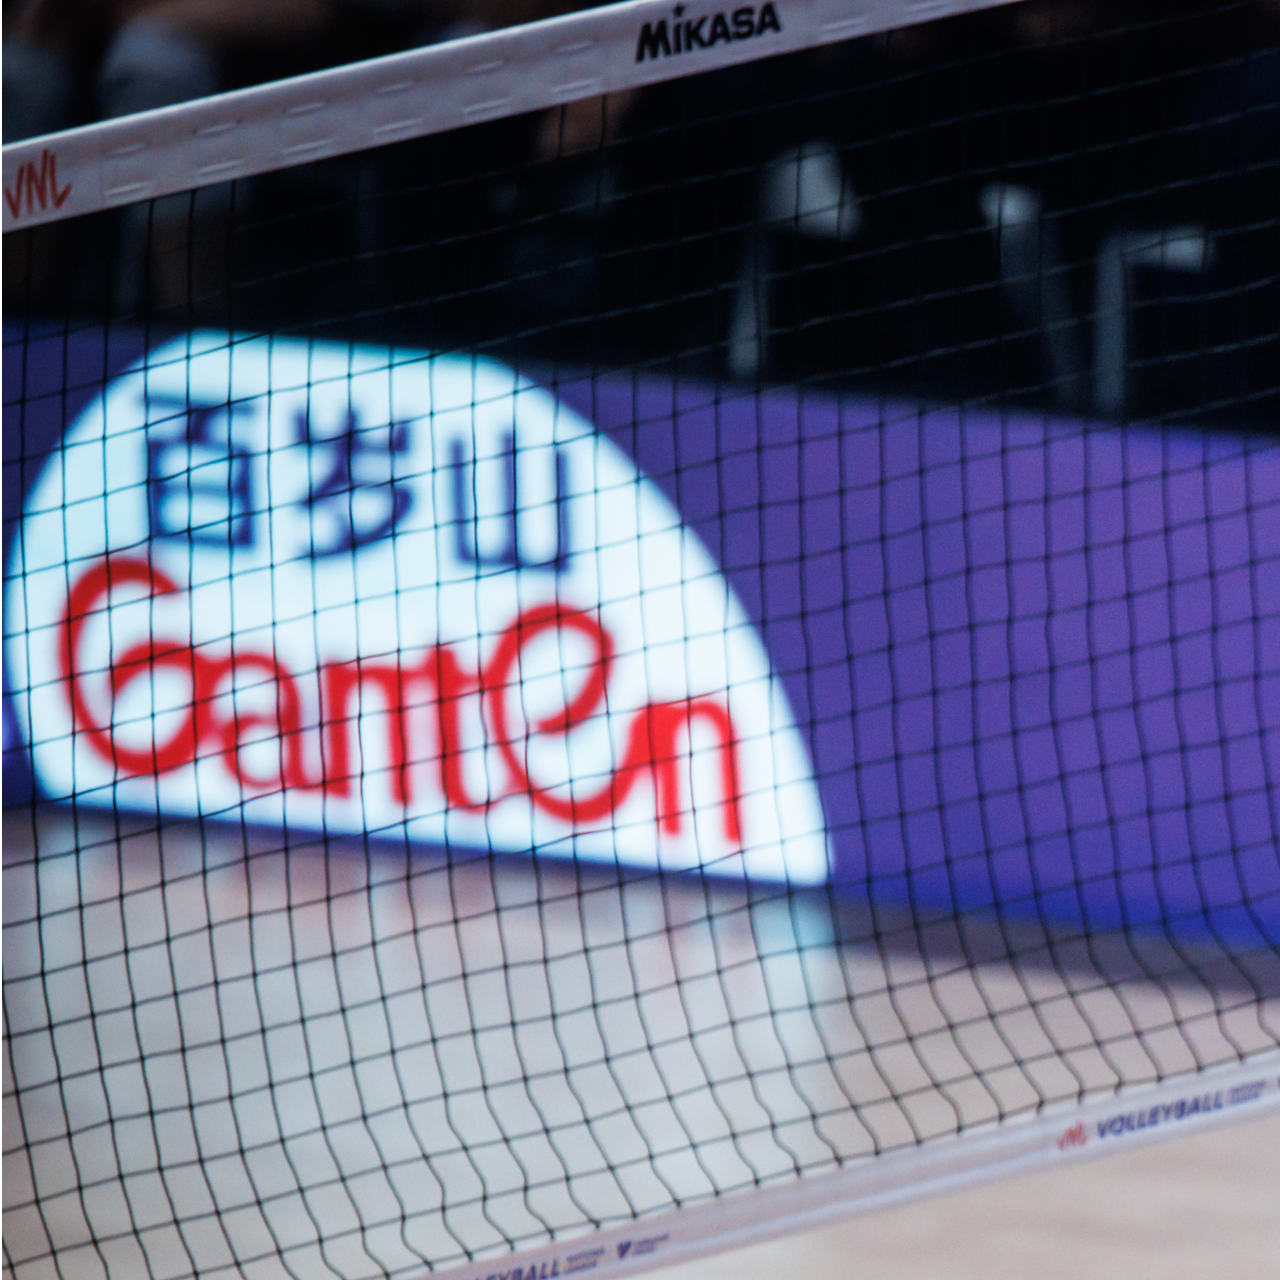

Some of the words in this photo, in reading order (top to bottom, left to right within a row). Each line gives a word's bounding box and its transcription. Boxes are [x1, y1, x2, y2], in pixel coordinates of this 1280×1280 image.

[3, 149, 73, 219] VNL
[138, 393, 574, 575] 百岁山
[1096, 1091, 1225, 1139] VOLLEYBALL
